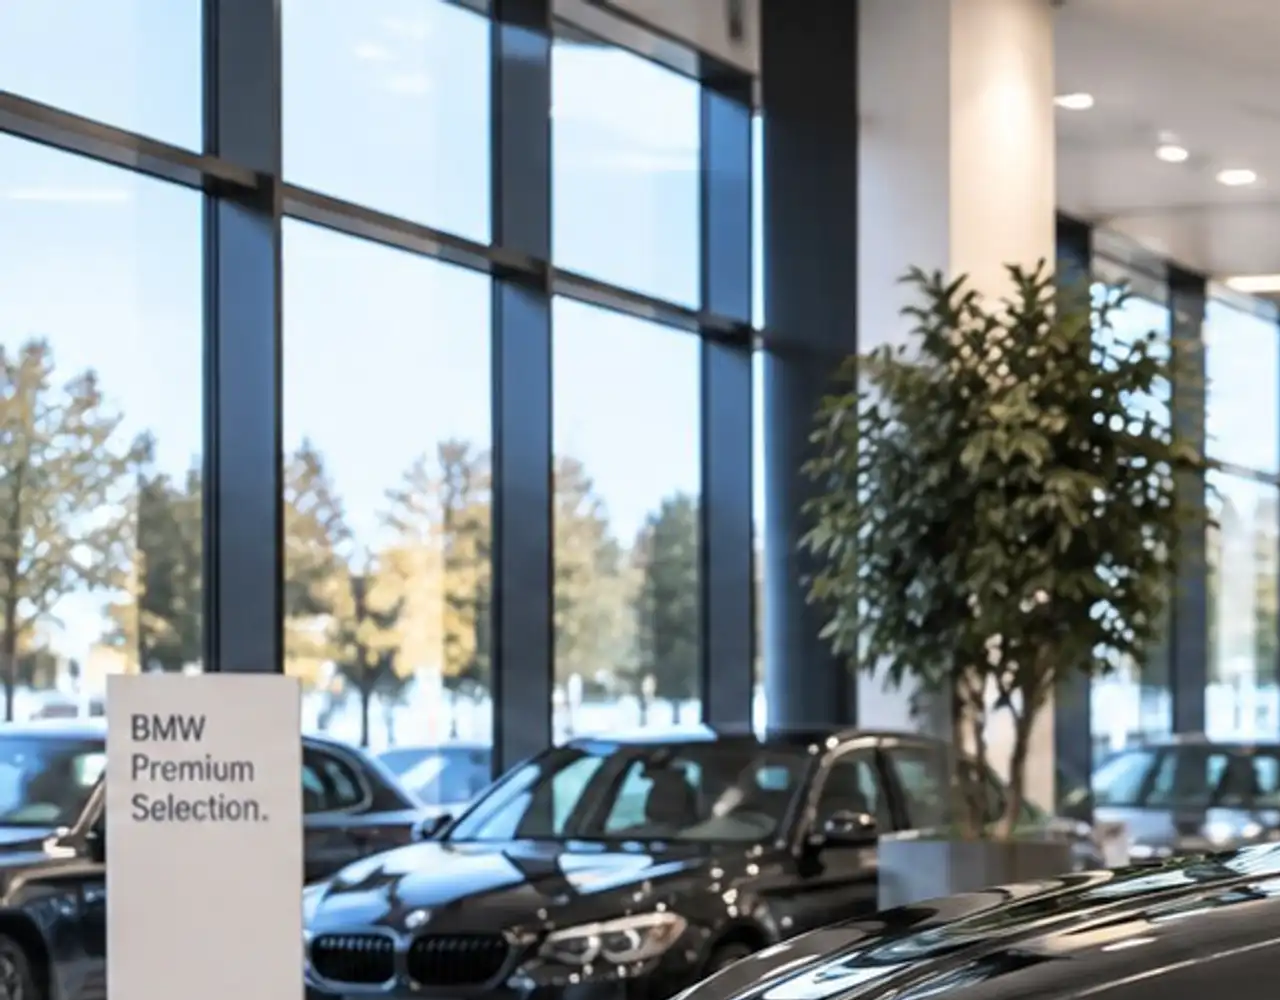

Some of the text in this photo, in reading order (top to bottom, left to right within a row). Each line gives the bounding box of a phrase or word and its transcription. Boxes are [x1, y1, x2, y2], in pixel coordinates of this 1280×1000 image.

[131, 713, 206, 742] BMW
[131, 752, 255, 783] Premium
[131, 792, 269, 823] Selection.
